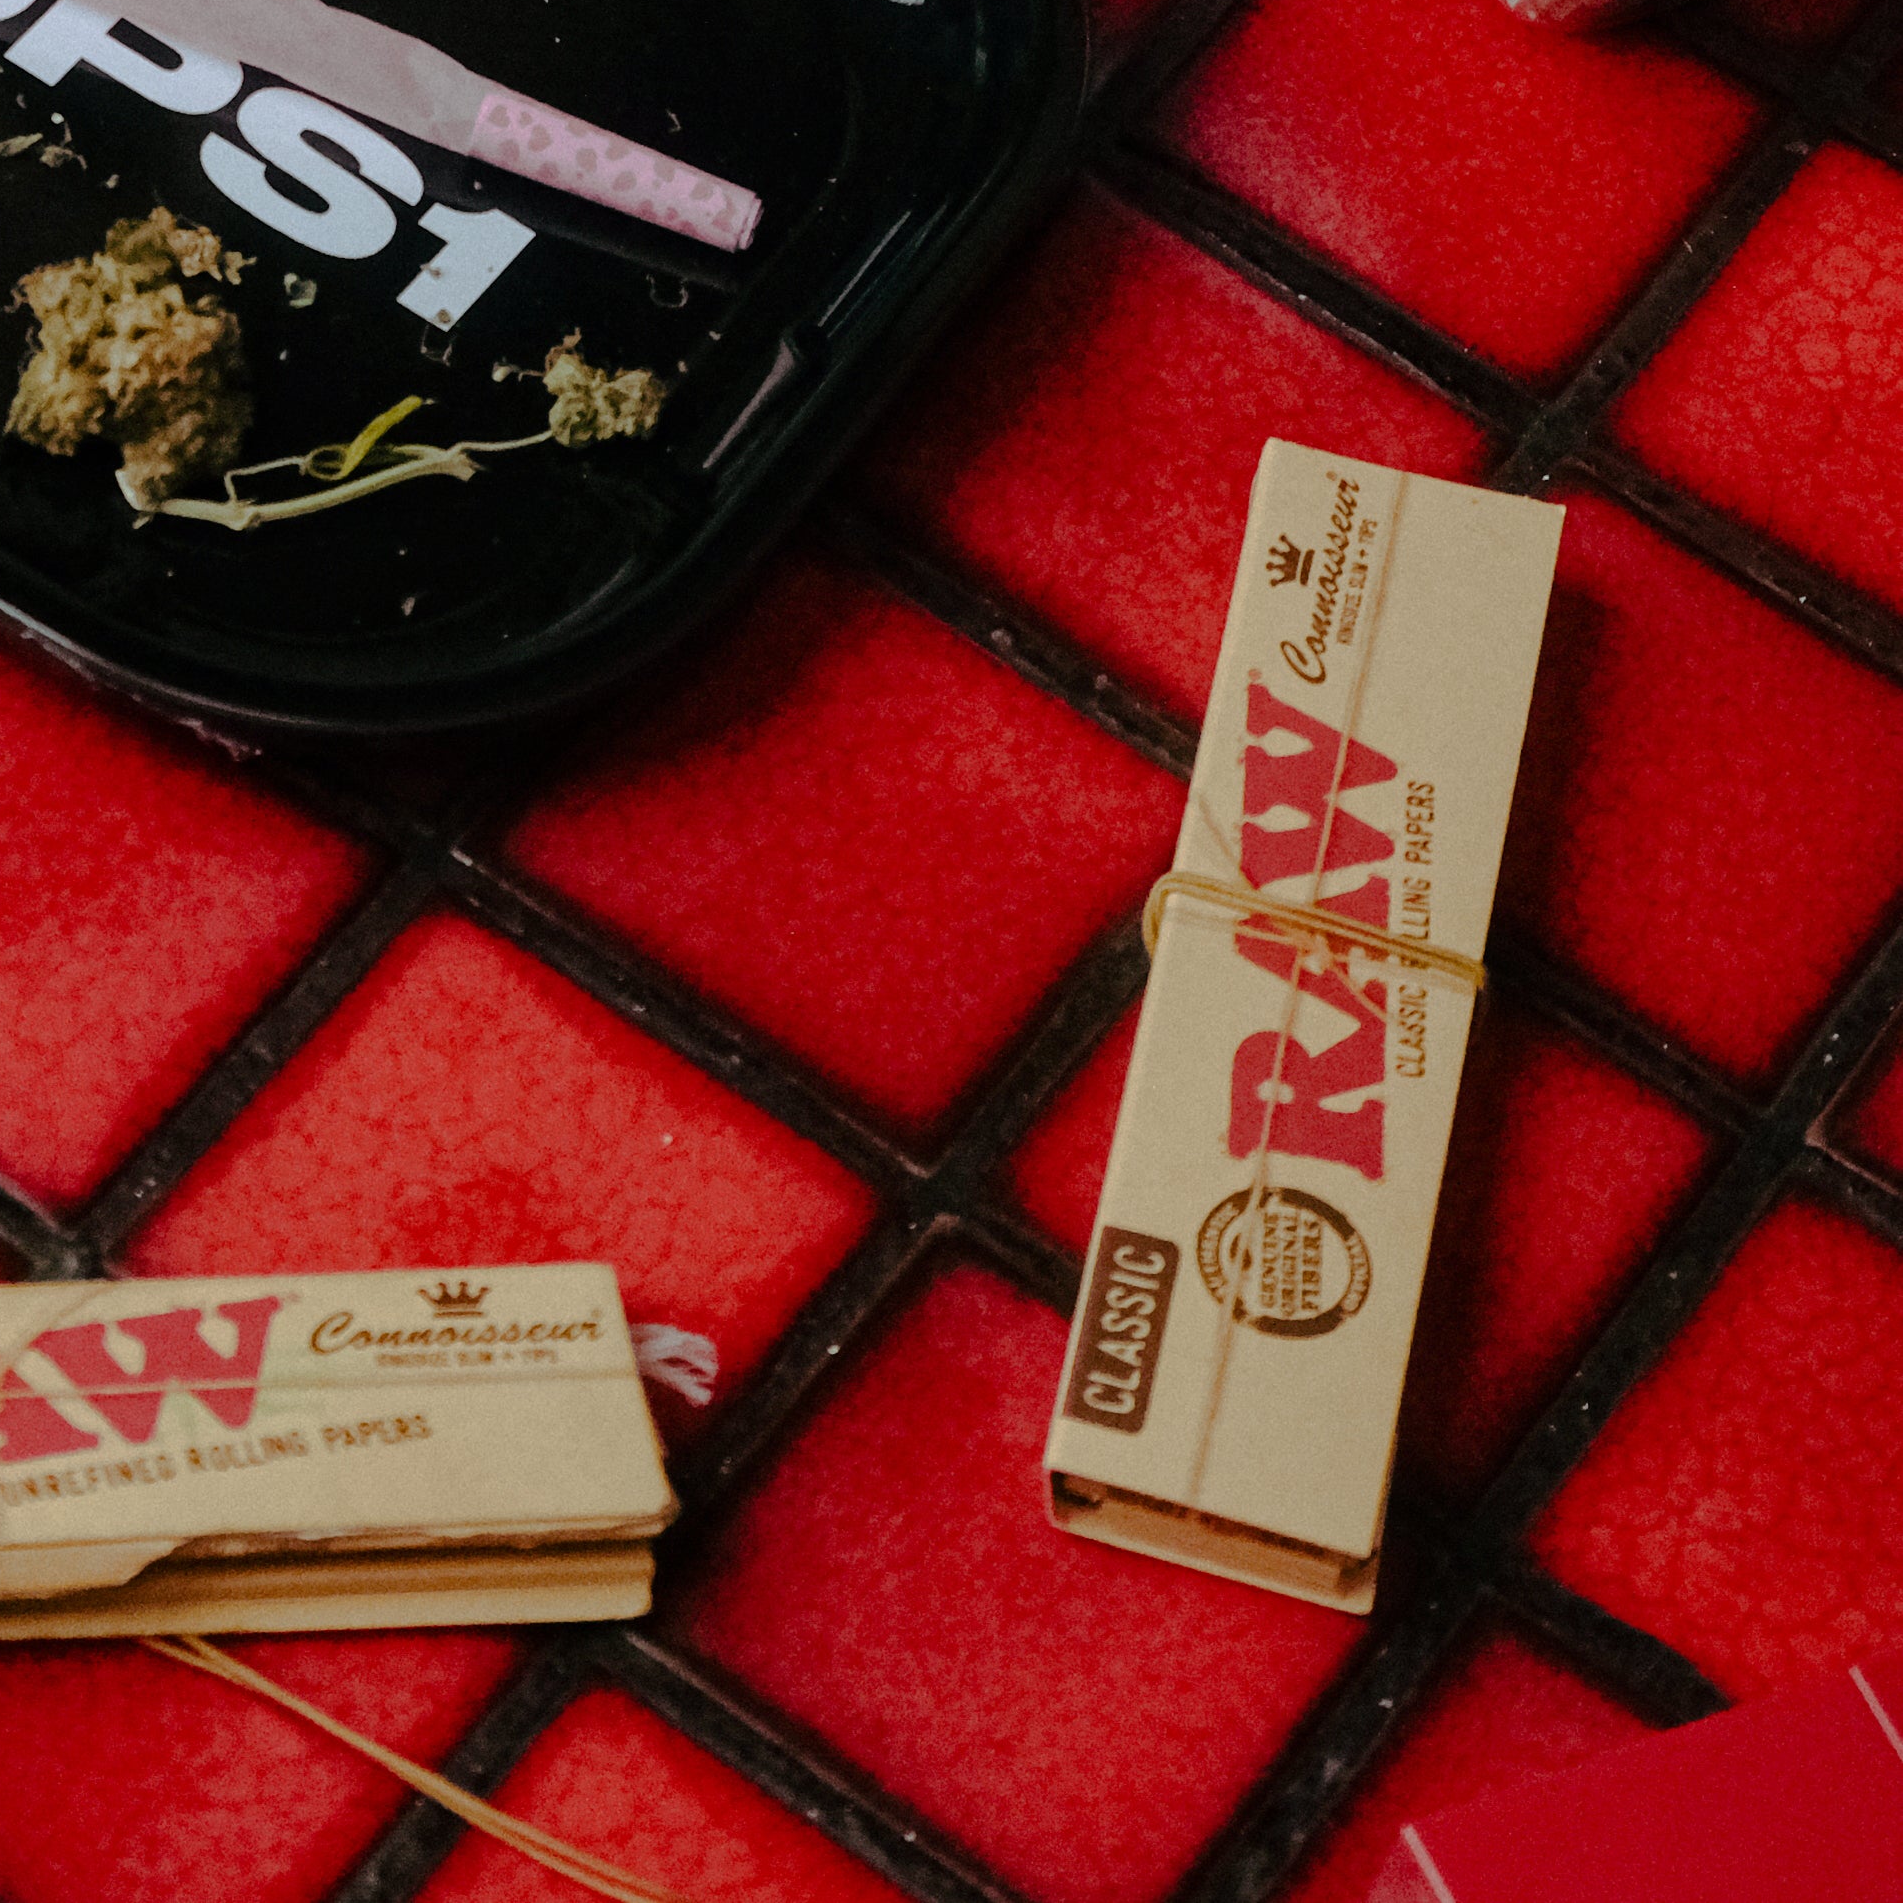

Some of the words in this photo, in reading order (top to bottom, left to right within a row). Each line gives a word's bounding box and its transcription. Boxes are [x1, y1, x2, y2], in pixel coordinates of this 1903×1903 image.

[1280, 477, 1361, 685] Connoisseur
[1404, 779, 1436, 866] PAPERS
[1228, 682, 1399, 1182] RAW
[1395, 983, 1428, 1079] CLASSIC
[1301, 1219, 1323, 1311] FIBERS
[310, 1310, 603, 1356] Connoisseur
[1082, 1243, 1167, 1416] CLASSIC
[184, 1429, 310, 1475] ROLLING
[322, 1413, 433, 1454] PAPERS
